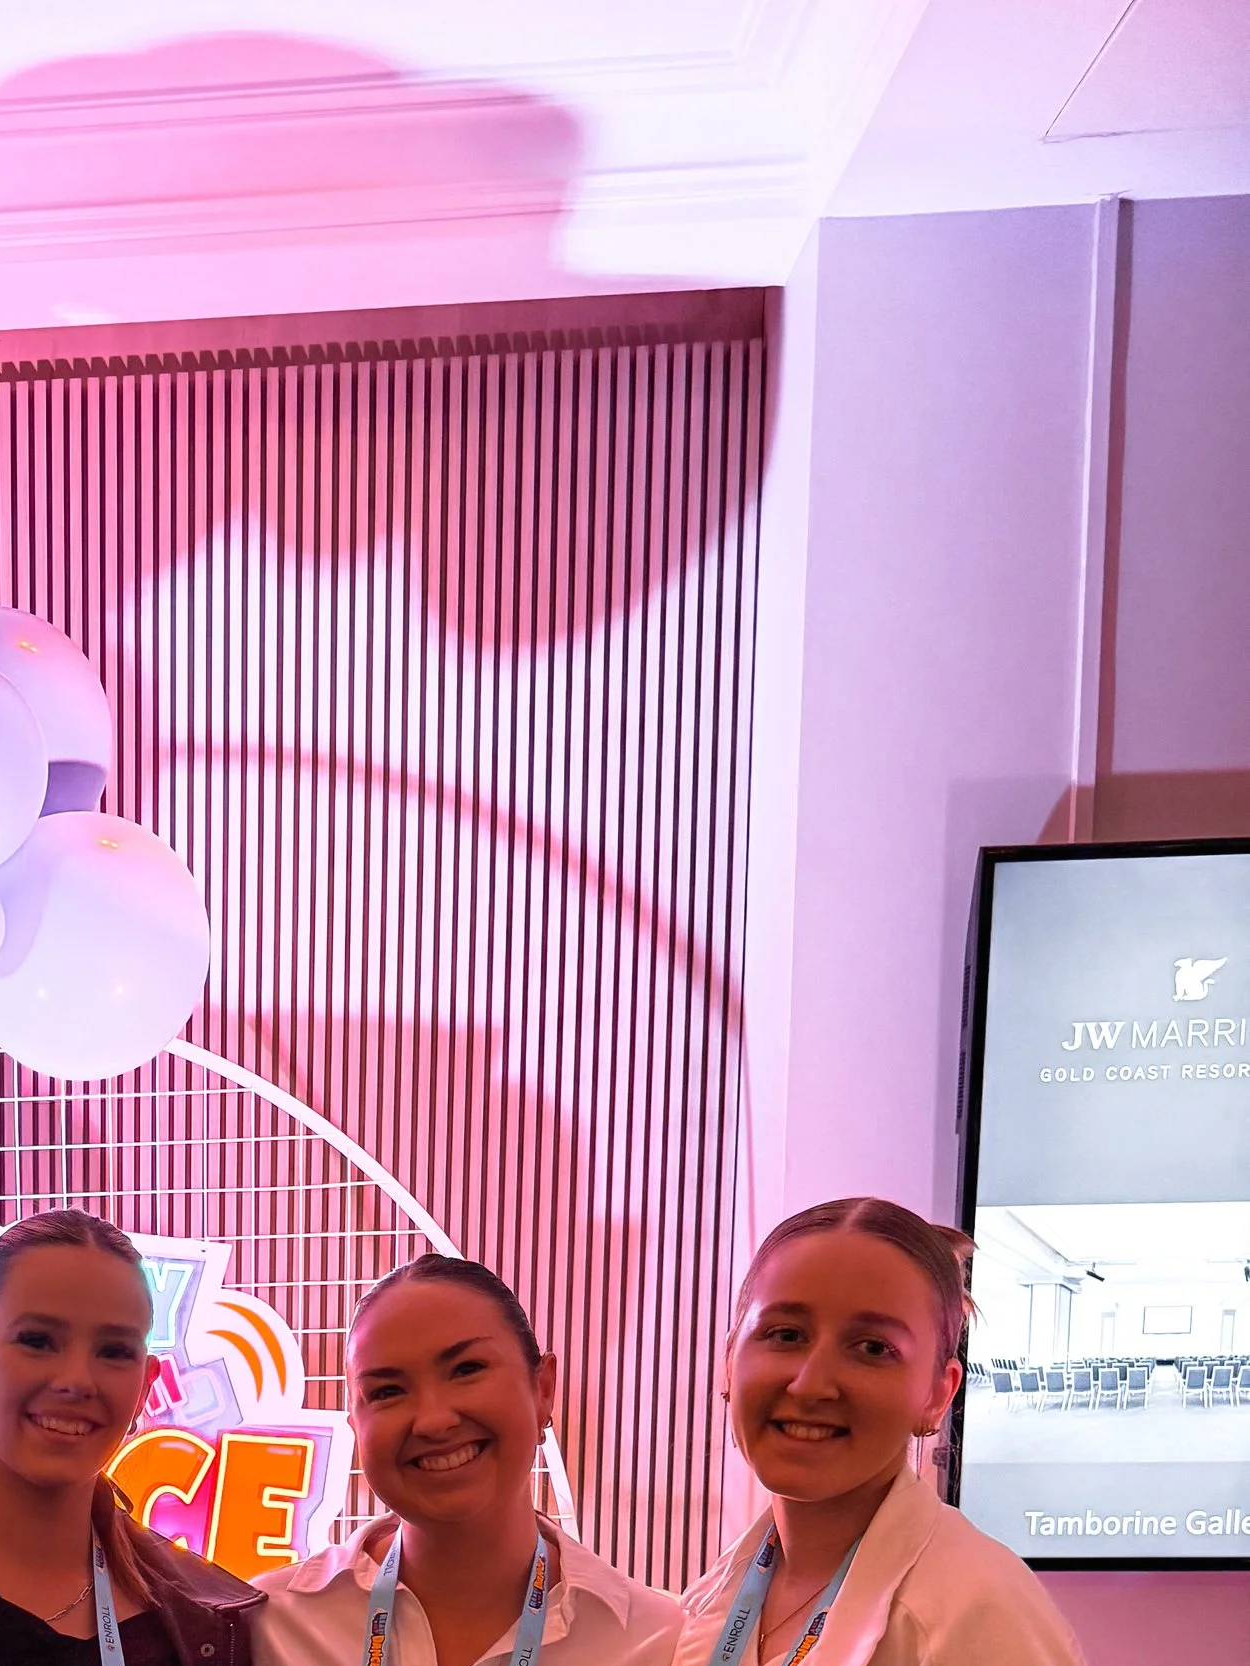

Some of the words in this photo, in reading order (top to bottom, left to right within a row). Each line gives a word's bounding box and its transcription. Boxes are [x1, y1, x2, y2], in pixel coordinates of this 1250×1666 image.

[1061, 1020, 1126, 1051] JW
[1131, 1018, 1247, 1049] MARRI
[1038, 1067, 1095, 1083] GOLD
[1105, 1064, 1171, 1081] COAST
[1024, 1509, 1177, 1536] Tamborine
[102, 1604, 116, 1645] ENROLL
[723, 1608, 751, 1654] ENROLL
